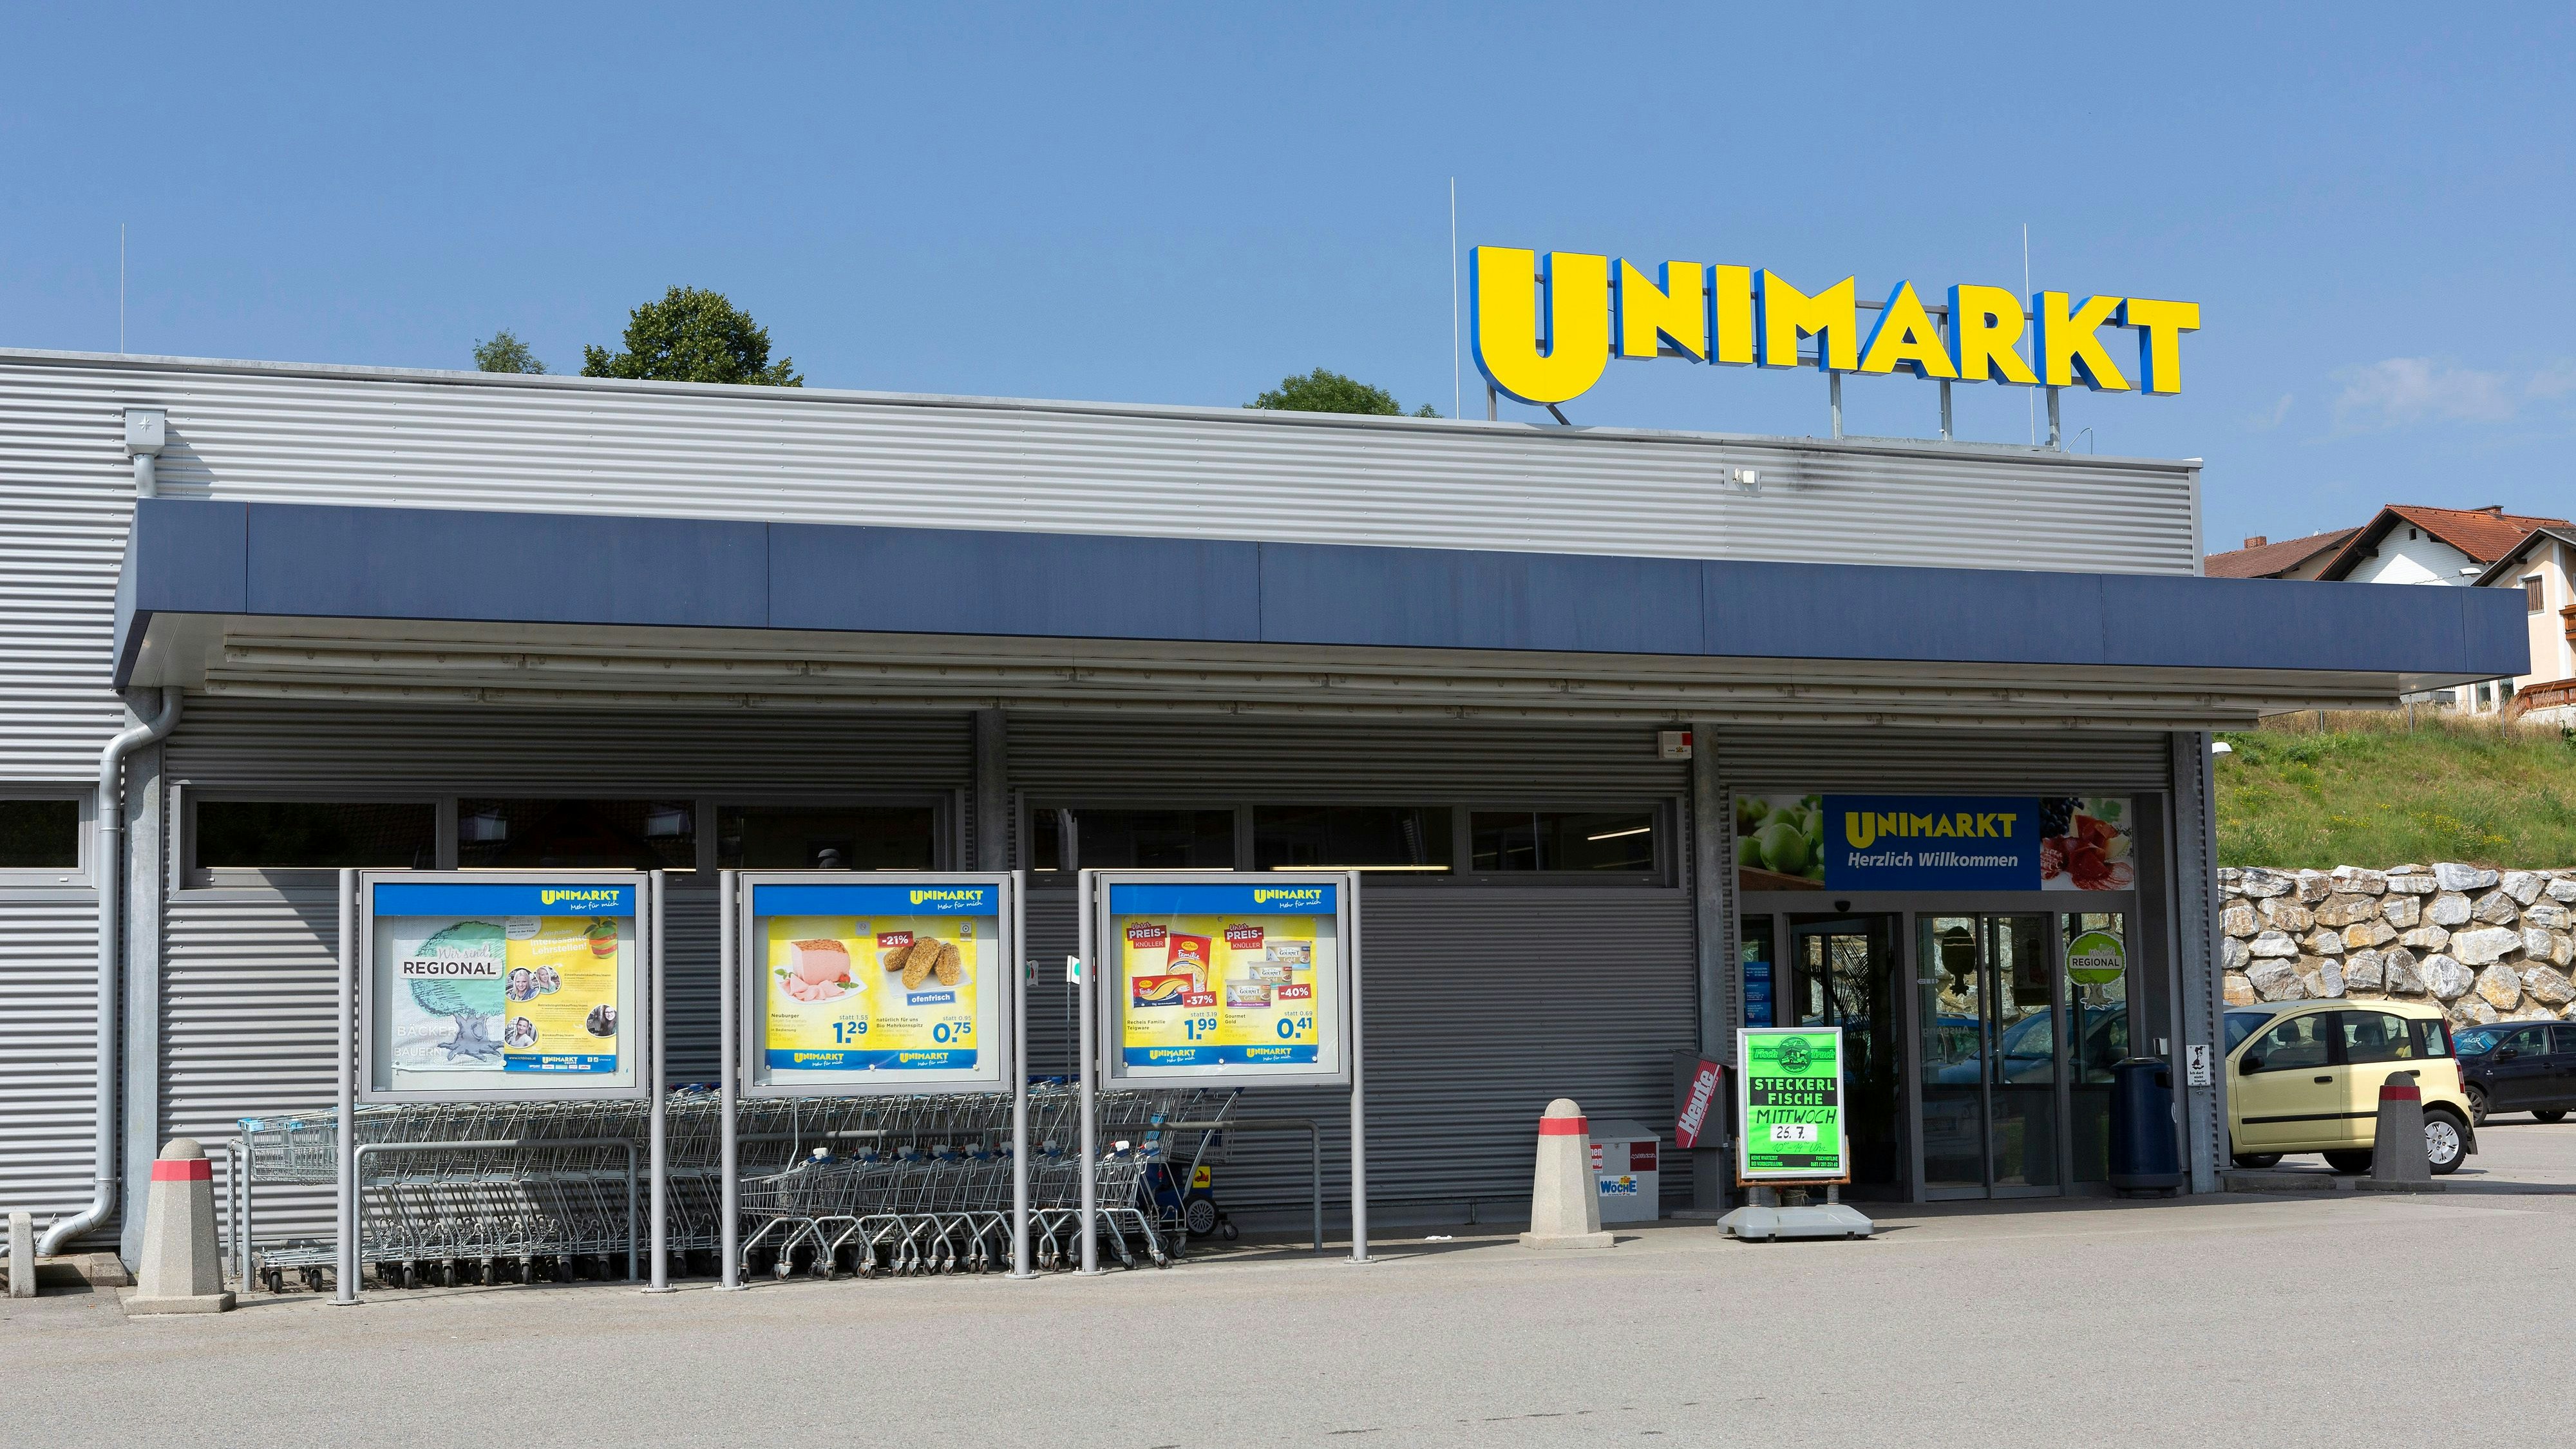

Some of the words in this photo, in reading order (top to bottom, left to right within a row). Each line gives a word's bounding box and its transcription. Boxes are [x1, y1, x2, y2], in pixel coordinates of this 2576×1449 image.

[1469, 245, 2200, 406] UNIMARKT
[1845, 811, 2016, 848] UNIMARKT
[1848, 851, 1913, 867] Herzlich
[1918, 851, 2018, 867] Willkommen
[542, 890, 619, 905] UNIMARKT
[910, 891, 983, 905] UNIMARKT
[1255, 889, 1321, 904] UNIMARKT
[589, 902, 599, 910] für
[882, 936, 908, 945] -21%
[1129, 929, 1165, 939] PREIS-
[1227, 930, 1262, 940] PREIS-
[531, 935, 587, 947] Interessante
[439, 948, 461, 959] Wir
[464, 945, 487, 958] sind
[532, 942, 587, 955] Lehrstellen!
[1178, 950, 1200, 960] Familie
[404, 961, 496, 975] REGIONAL
[1281, 987, 1309, 996] -40%
[912, 994, 951, 1003] ofenfrisch
[1187, 995, 1213, 1005] -37%
[397, 1024, 459, 1037] BÄCKER
[833, 1021, 867, 1044] 1.29
[933, 1022, 971, 1043] 0.75
[1184, 1018, 1217, 1039] 1.99
[1277, 1018, 1312, 1039] 0.41
[394, 1047, 443, 1057] BAUERN
[1754, 1048, 1777, 1057] Fisch
[1811, 1049, 1835, 1059] Truck
[1755, 1079, 1835, 1090] STECKERL
[1678, 1070, 1714, 1135] Heute
[1768, 1093, 1823, 1104] FISCHE
[1756, 1109, 1837, 1124] MITTWOCH
[1777, 1126, 1791, 1139] 26.
[1796, 1126, 1804, 1139] 7.
[1810, 1143, 1828, 1152] Uhr
[1600, 1180, 1636, 1193] WOCHE
